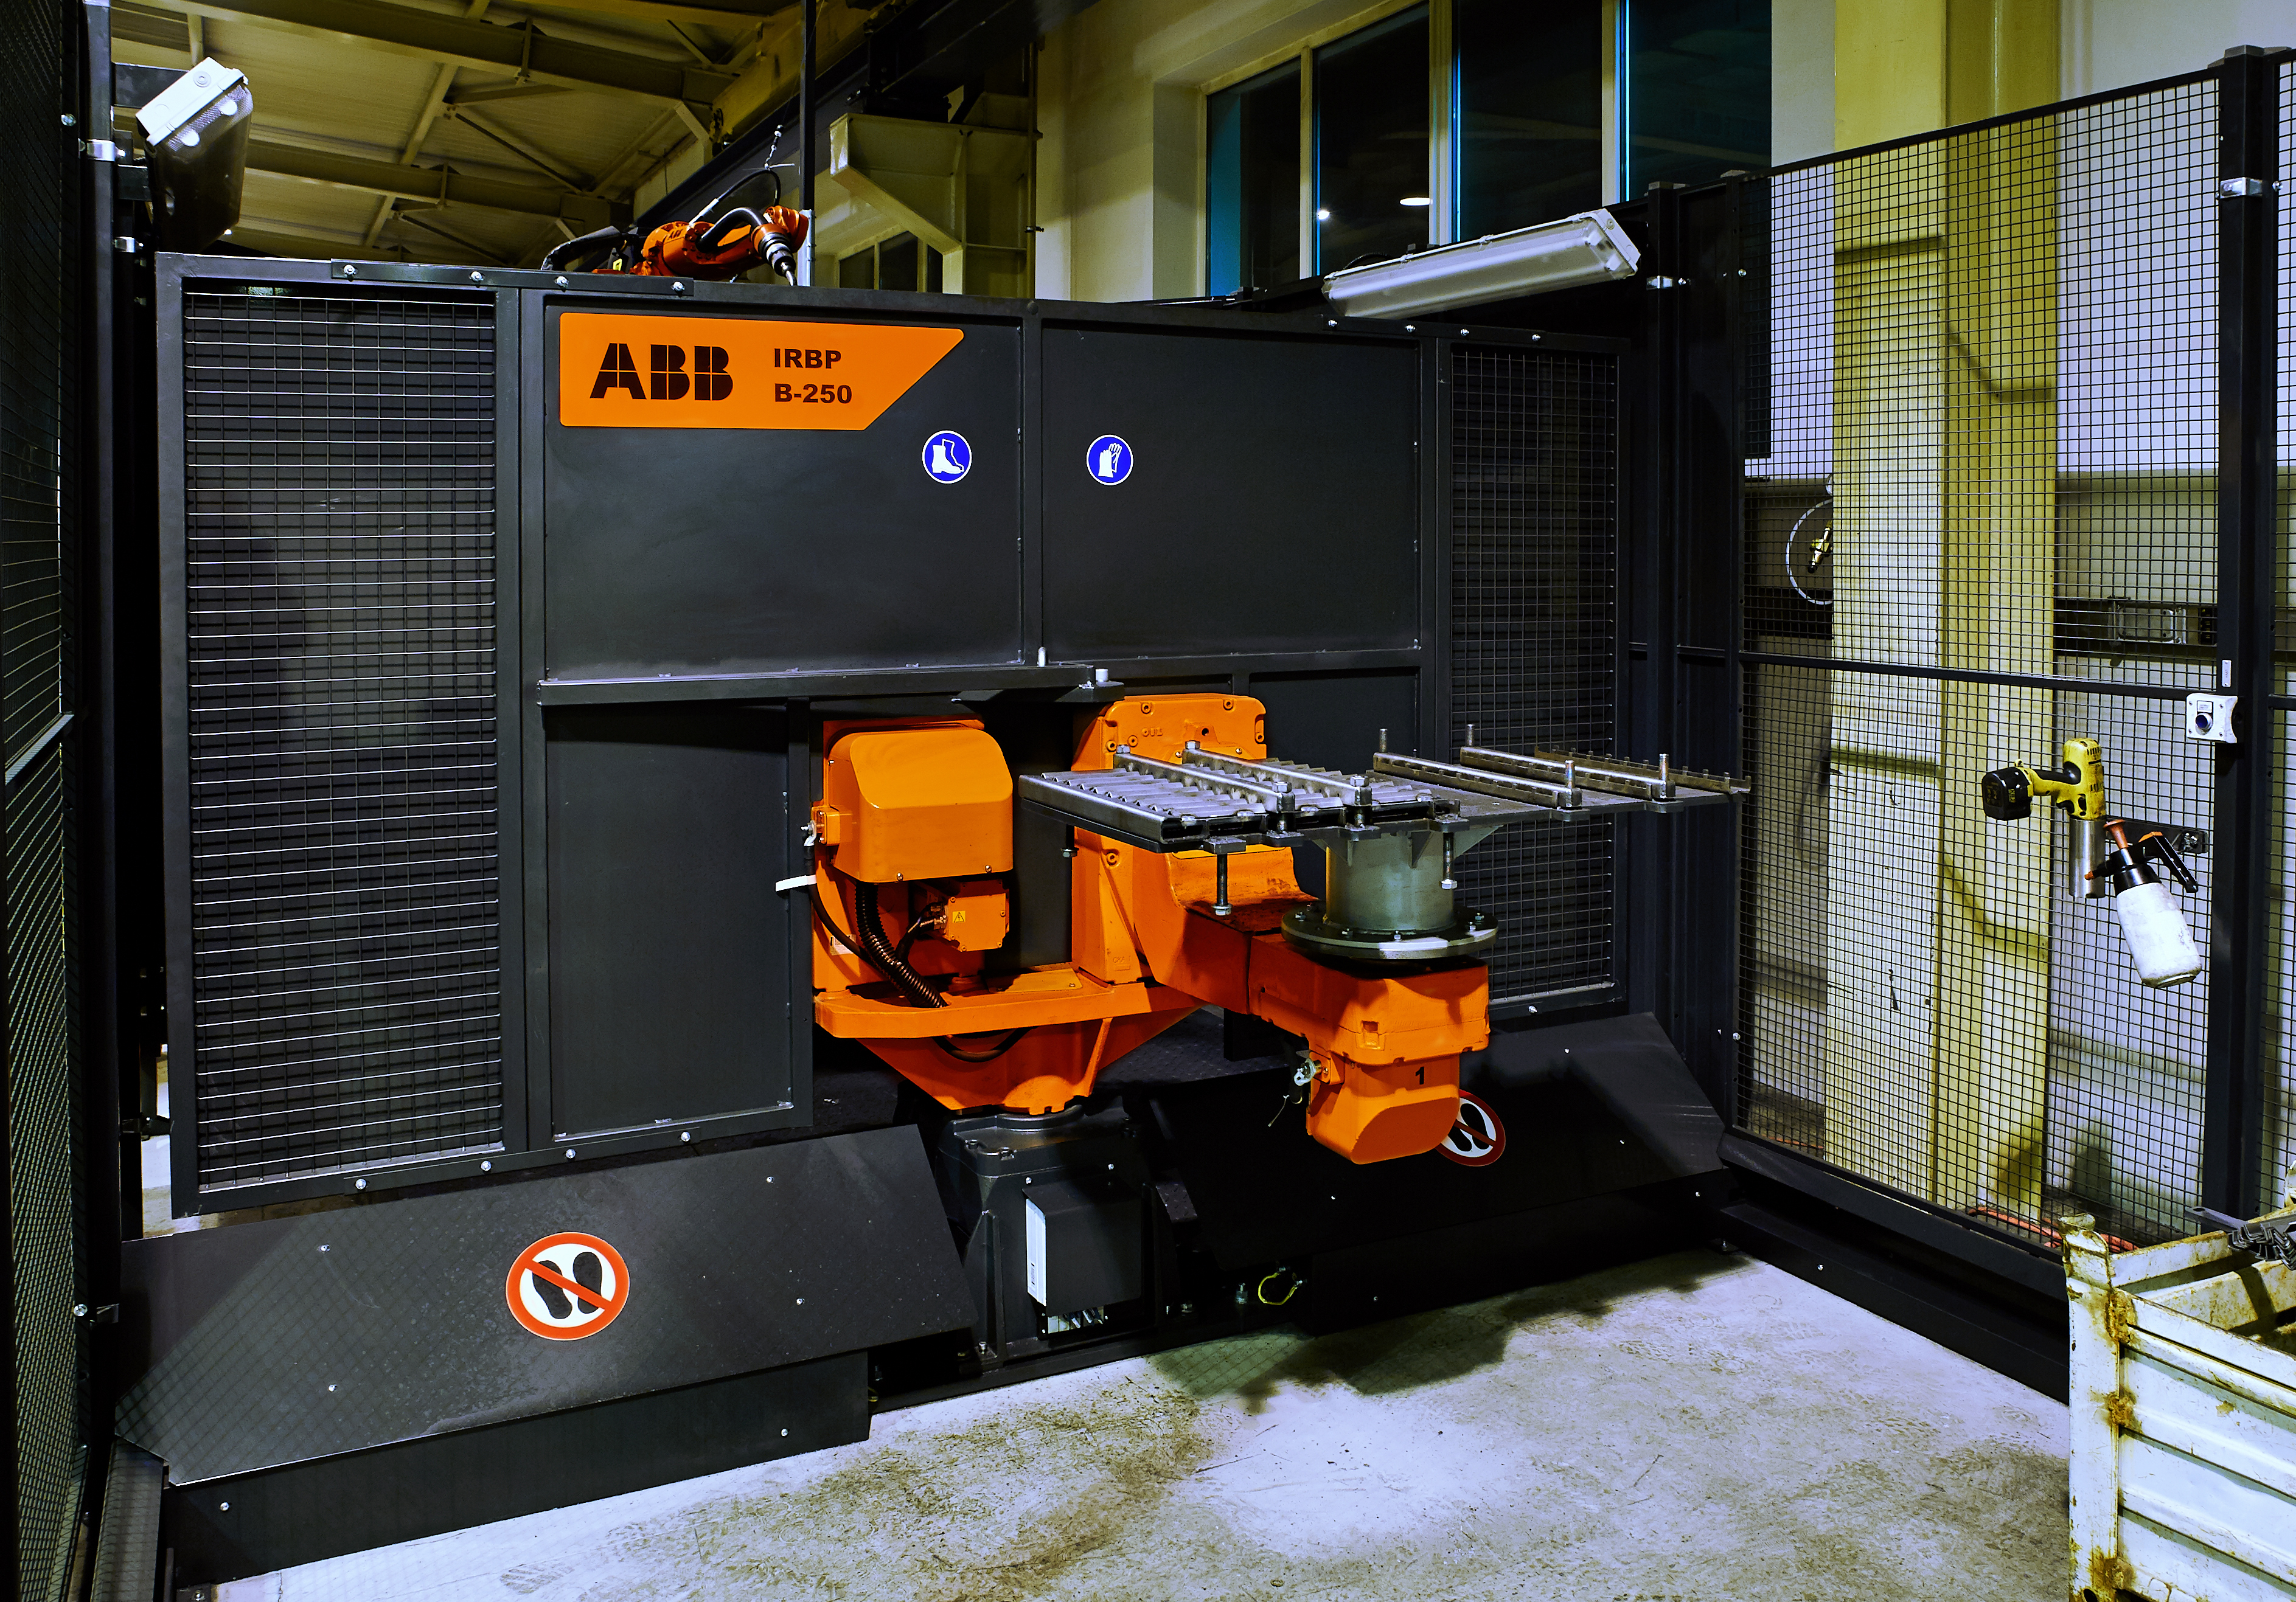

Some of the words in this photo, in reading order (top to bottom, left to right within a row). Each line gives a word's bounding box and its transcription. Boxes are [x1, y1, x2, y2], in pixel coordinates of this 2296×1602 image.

[774, 348, 841, 369] IRBP
[590, 342, 733, 401] ABB
[774, 383, 852, 404] B-250
[1415, 1066, 1425, 1085] 1
